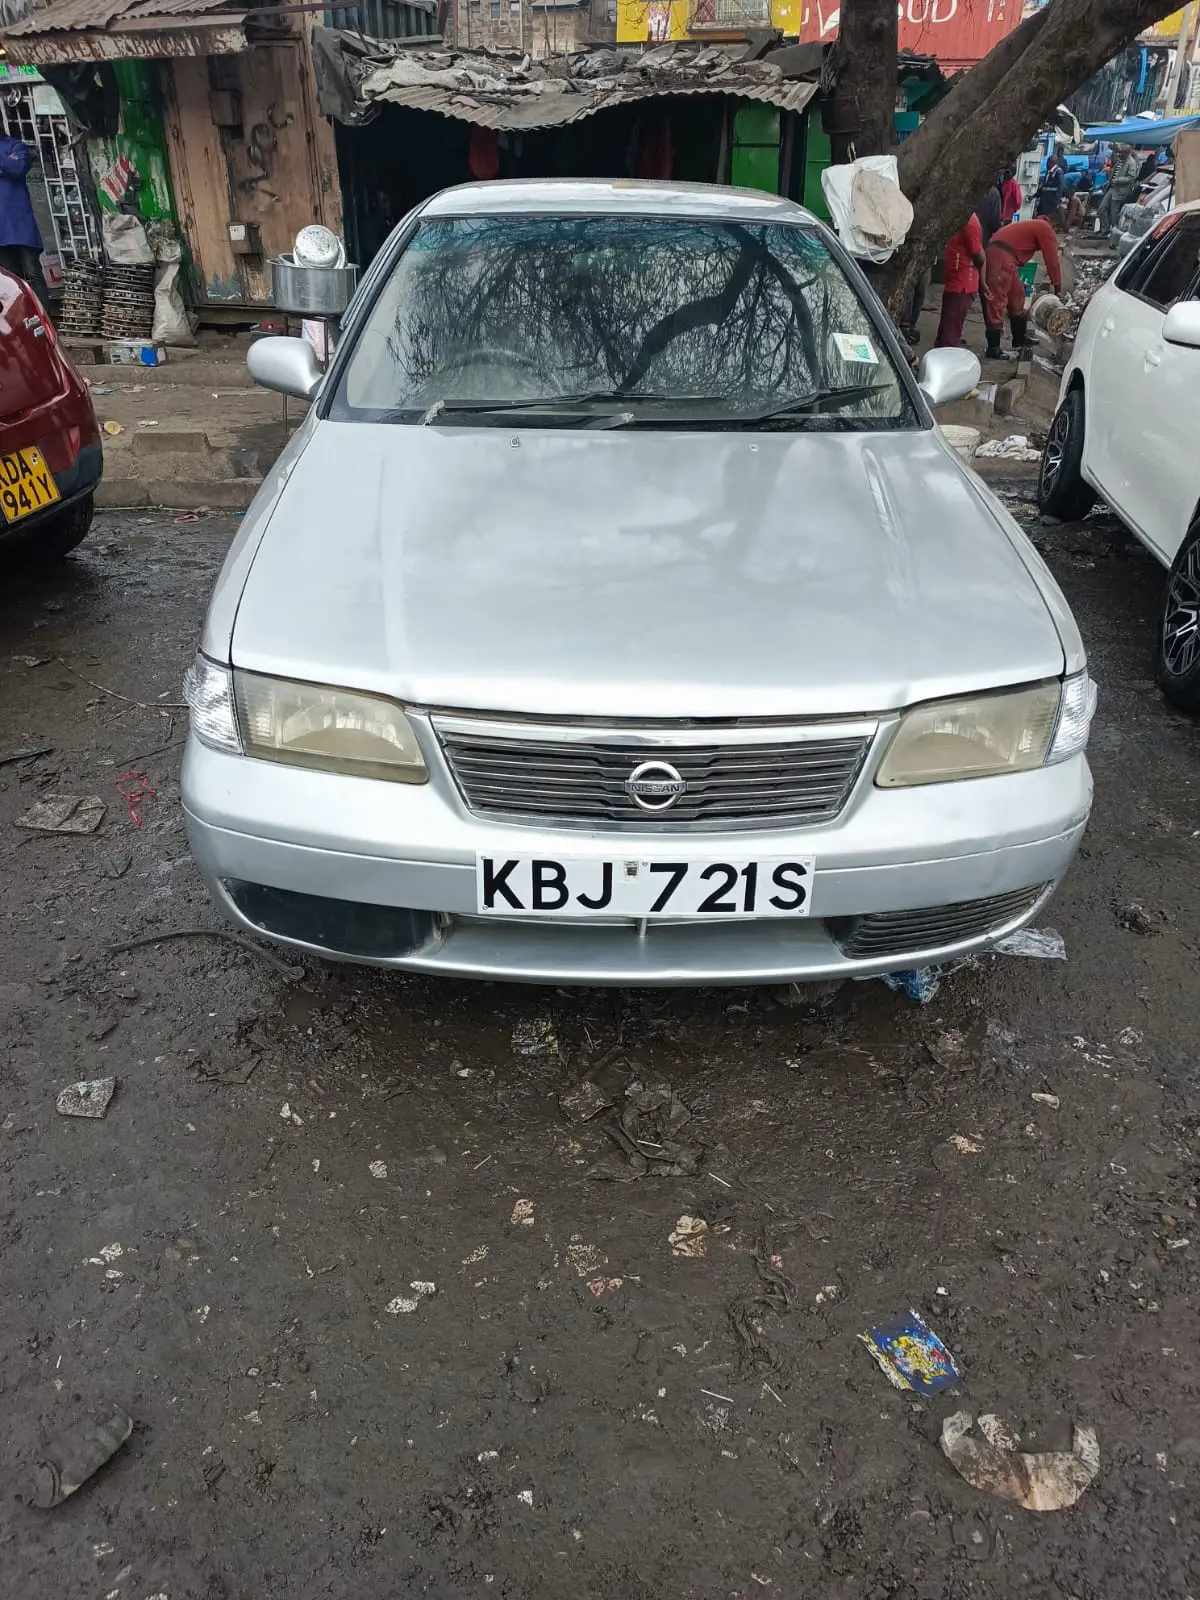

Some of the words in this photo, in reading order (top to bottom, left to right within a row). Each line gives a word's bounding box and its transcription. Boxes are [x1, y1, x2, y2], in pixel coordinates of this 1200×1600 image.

[3, 473, 52, 516] 941Y
[632, 784, 680, 792] NISSAN
[483, 859, 613, 911] KBJ
[649, 862, 807, 912] 721S
